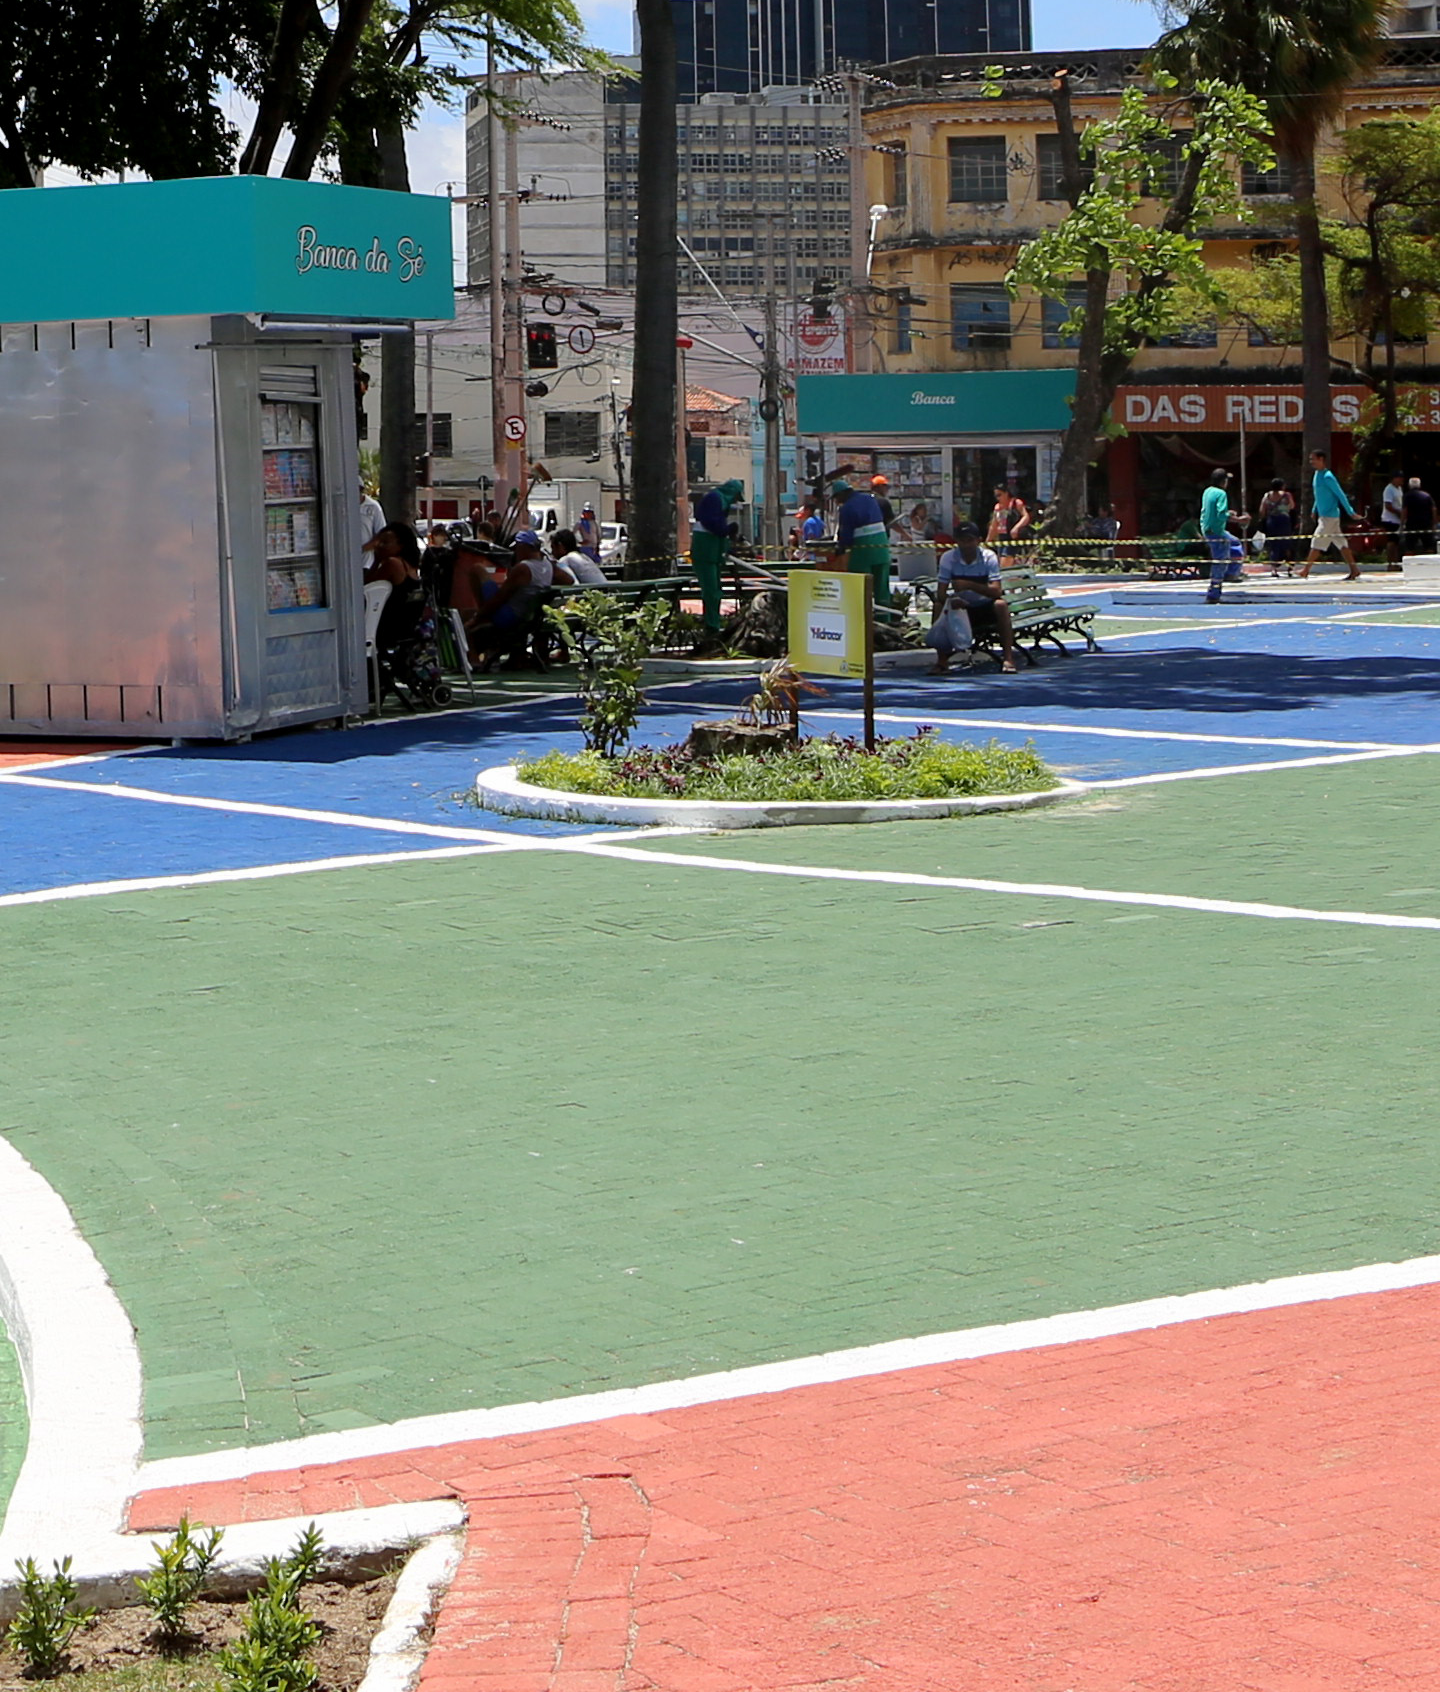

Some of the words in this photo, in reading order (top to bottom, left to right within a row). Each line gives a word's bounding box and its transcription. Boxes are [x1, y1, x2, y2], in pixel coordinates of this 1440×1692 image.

[296, 224, 360, 276] Banca
[365, 235, 391, 274] da
[397, 235, 427, 284] Sé
[786, 357, 845, 369] AMAZÉM
[910, 390, 957, 406] Banca
[1125, 394, 1207, 424] DAS
[1225, 394, 1361, 425] REDS
[511, 420, 521, 435] E
